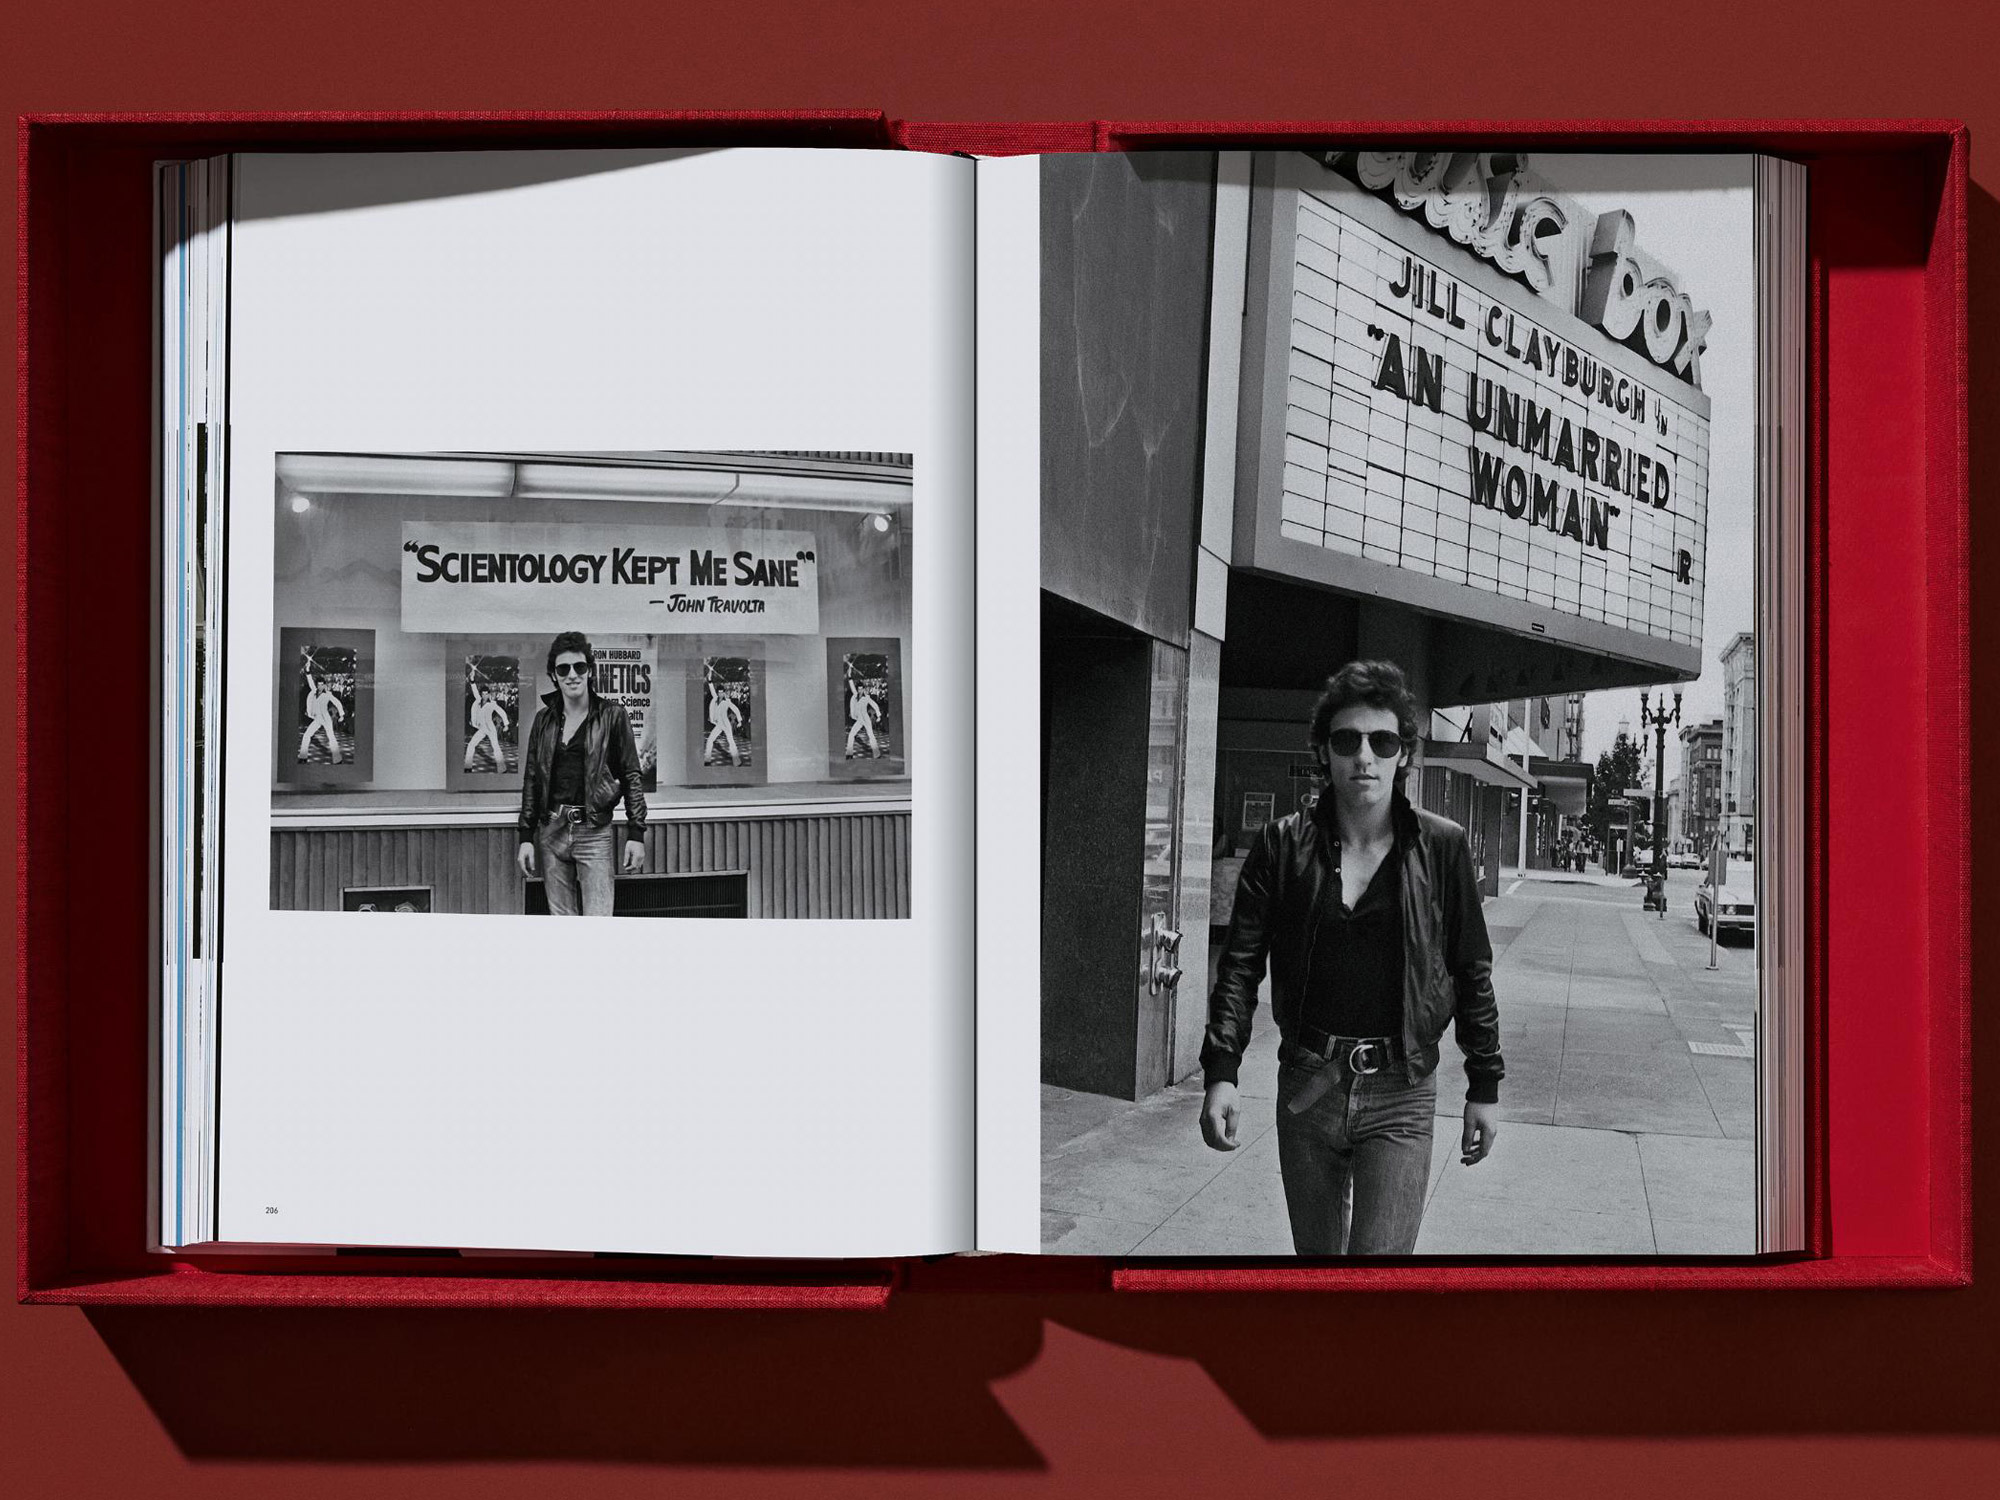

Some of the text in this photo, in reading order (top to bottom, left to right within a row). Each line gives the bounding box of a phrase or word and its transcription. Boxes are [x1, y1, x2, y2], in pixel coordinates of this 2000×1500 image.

[1580, 207, 1713, 386] box
[1389, 256, 1466, 331] JILL
[1485, 305, 1646, 424] CLAYBURGH
[1467, 371, 1670, 509] UNMARRIED
[1469, 445, 1621, 550] WOMAN”
[1677, 549, 1692, 586] R
[593, 649, 642, 660] RON HUBBARD
[621, 695, 651, 707] Science
[628, 709, 644, 721] alth
[265, 1206, 279, 1215] 206
